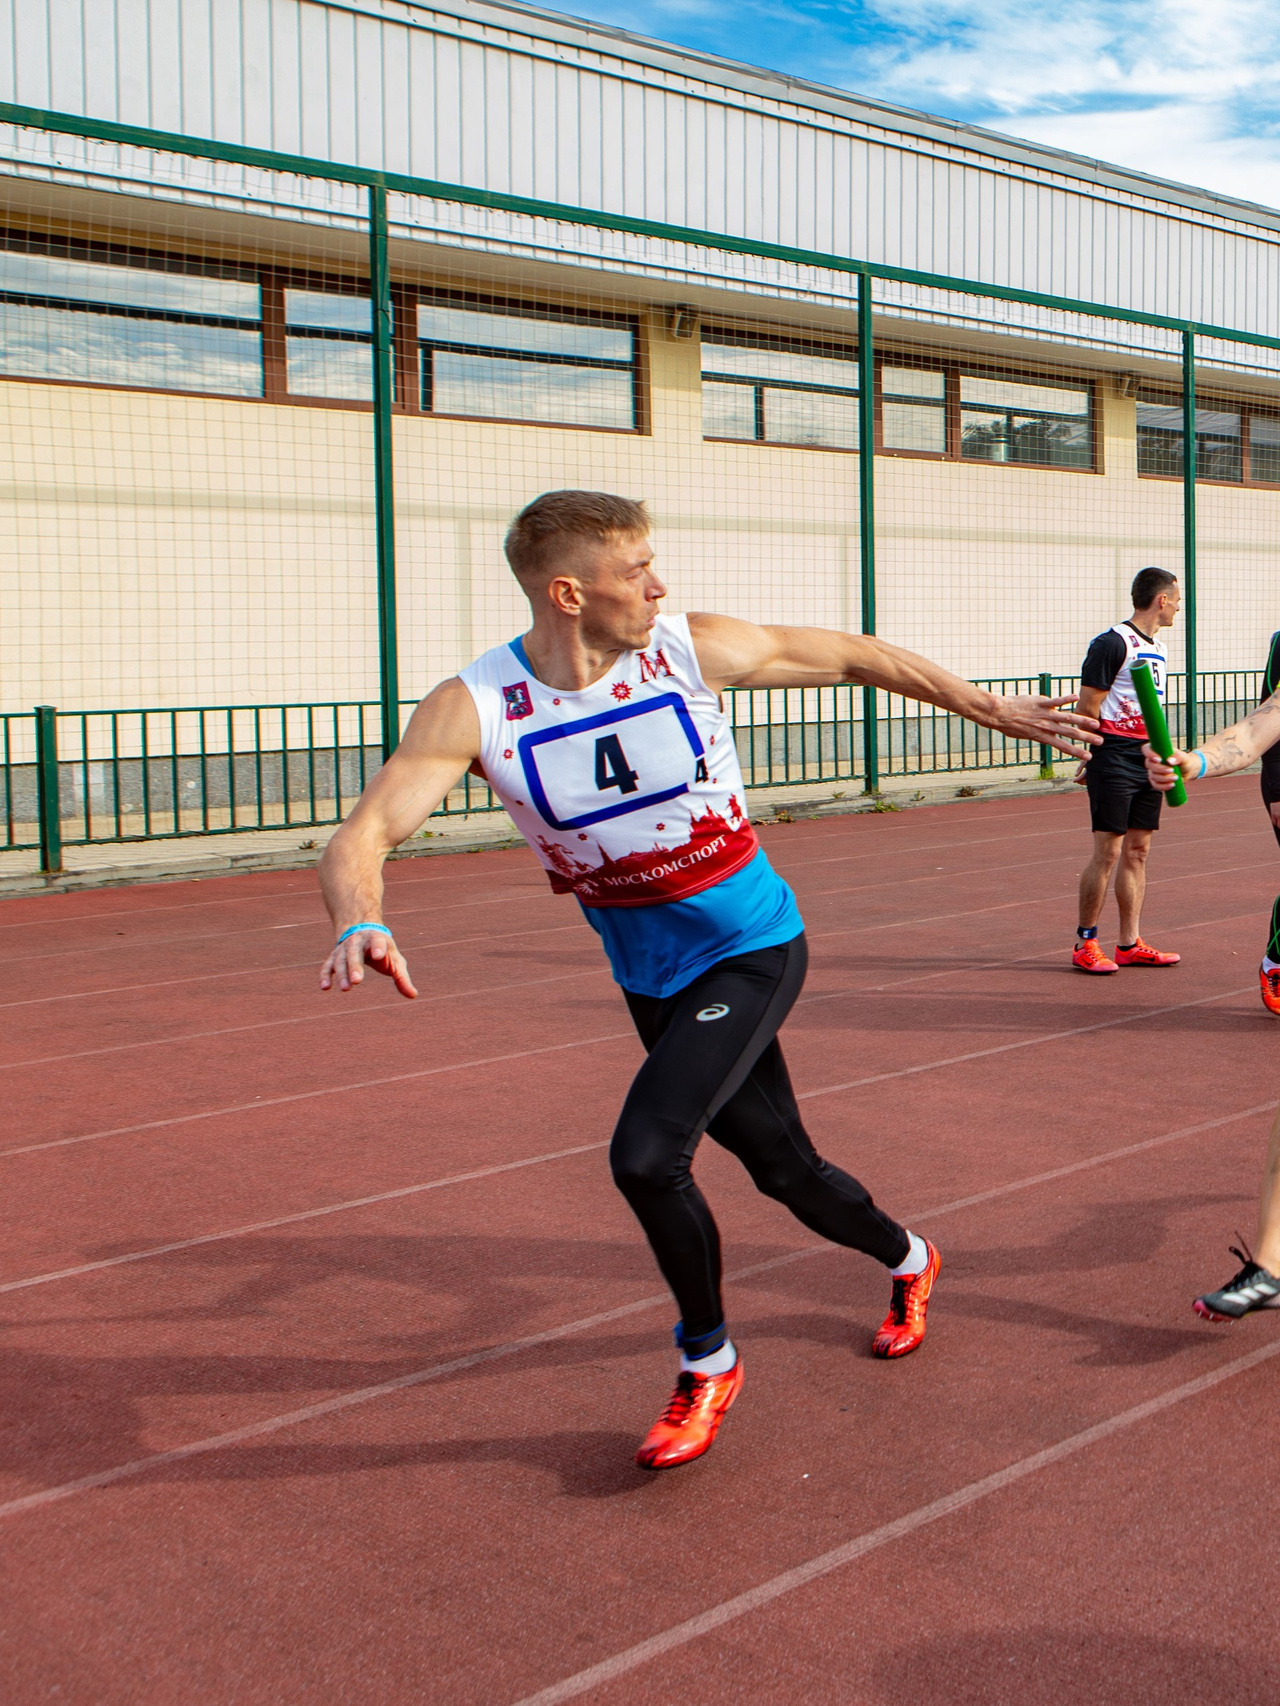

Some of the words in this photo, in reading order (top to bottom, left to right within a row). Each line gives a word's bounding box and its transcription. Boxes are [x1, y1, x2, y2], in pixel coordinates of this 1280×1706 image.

[1152, 662, 1160, 687] 5
[594, 733, 639, 795] 4
[695, 757, 709, 783] 4
[604, 835, 727, 886] МОСКОМСПОРТ
